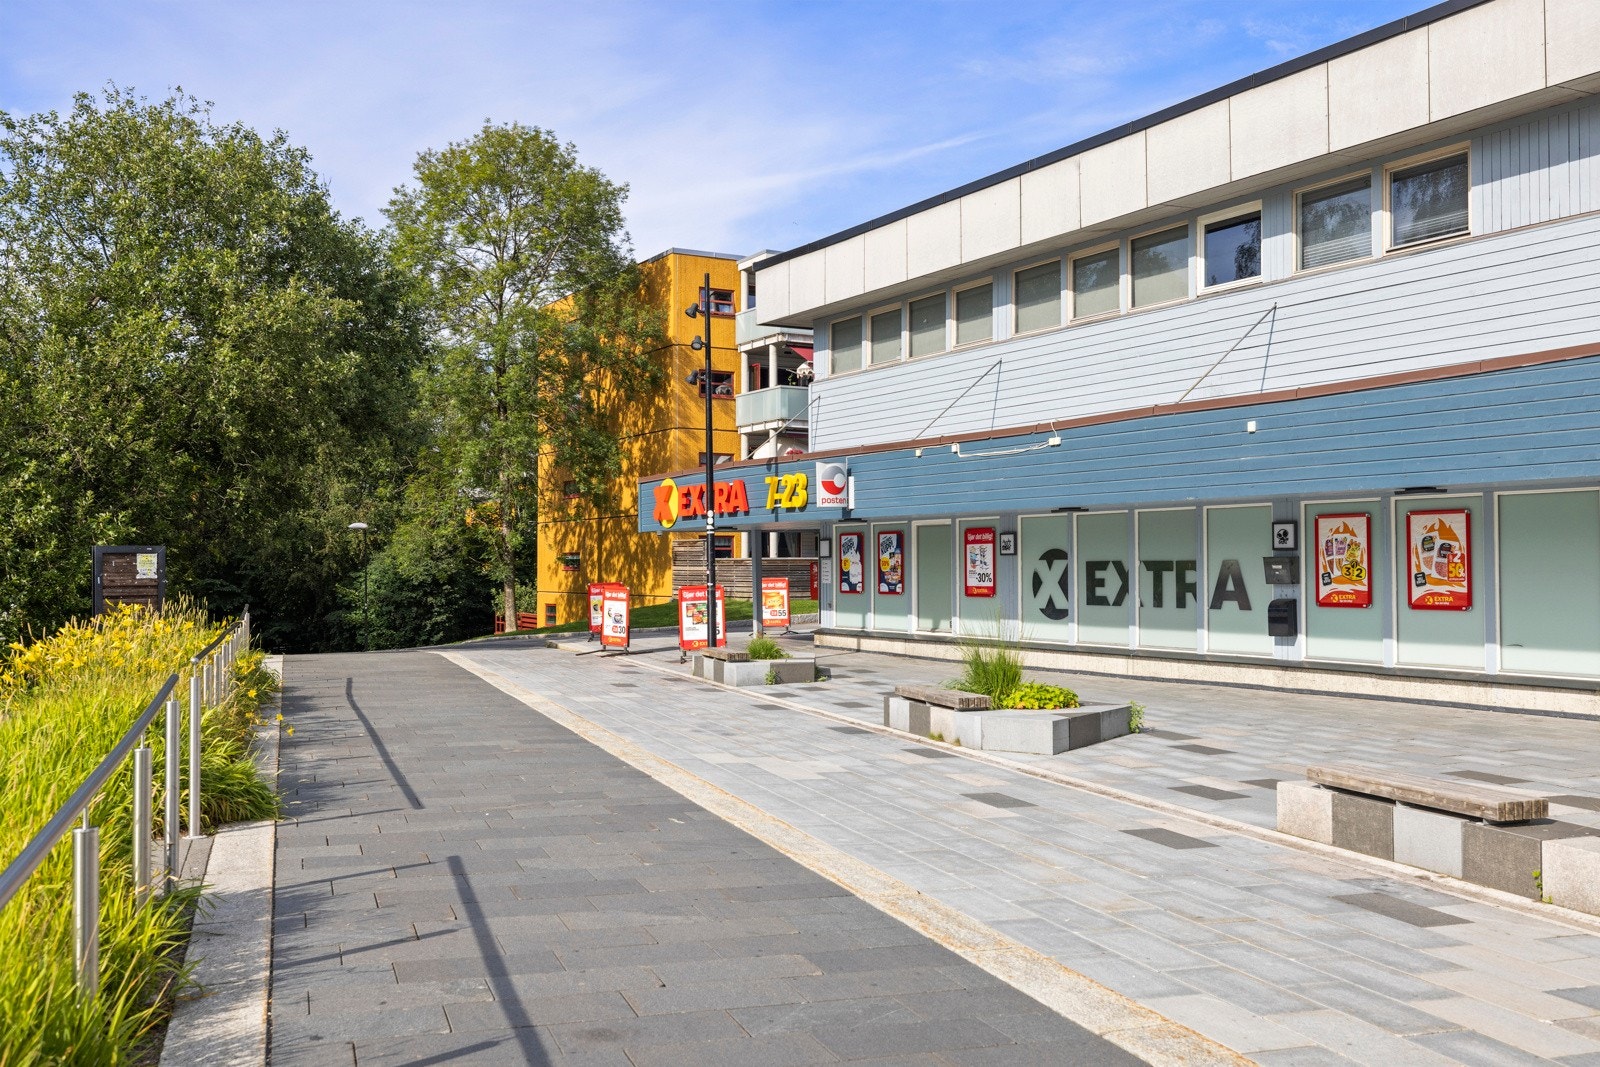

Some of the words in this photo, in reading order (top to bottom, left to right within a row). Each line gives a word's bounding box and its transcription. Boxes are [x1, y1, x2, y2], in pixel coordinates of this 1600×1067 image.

[678, 480, 749, 517] EXRA
[765, 473, 808, 510] 7-23
[821, 496, 847, 506] posten
[975, 572, 993, 583] -30%
[1343, 566, 1352, 577] 3
[1355, 568, 1363, 578] 2
[1085, 559, 1252, 611] EXTRA
